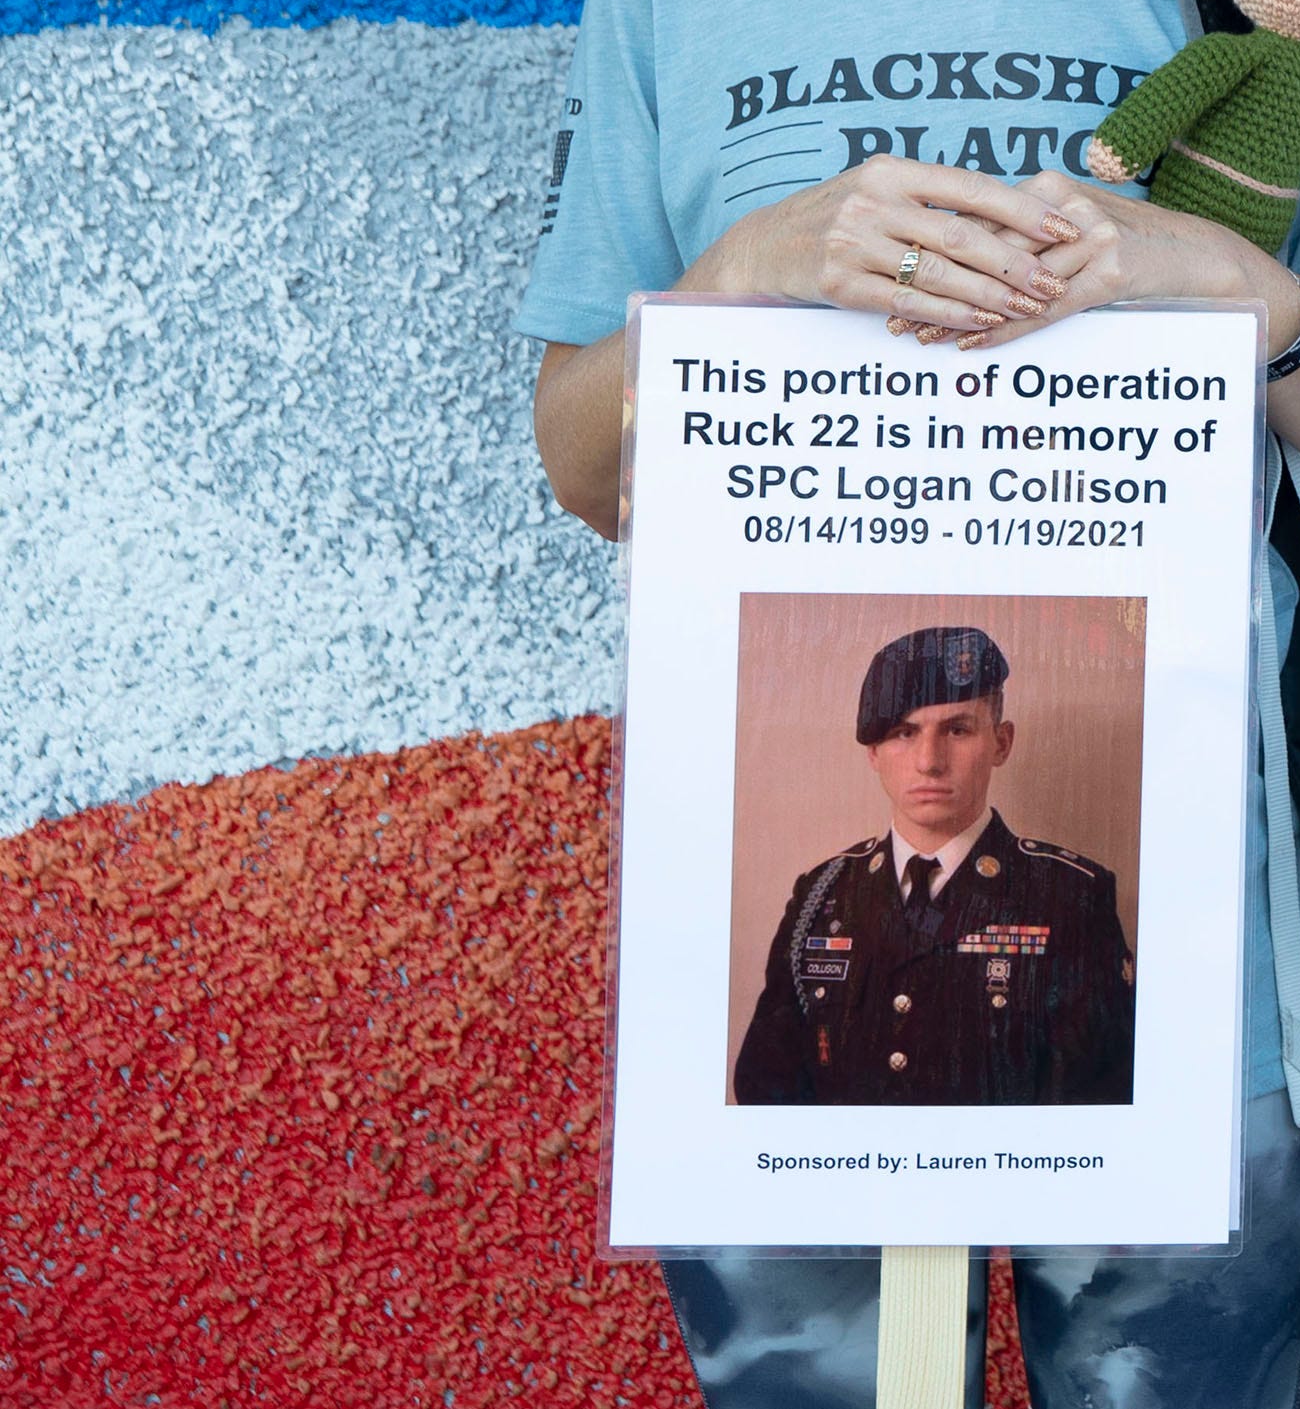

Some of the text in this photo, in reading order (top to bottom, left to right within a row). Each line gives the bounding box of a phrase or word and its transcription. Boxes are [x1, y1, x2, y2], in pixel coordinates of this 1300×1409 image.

[673, 359, 1226, 407] This portion of Operation
[684, 411, 1217, 461] Ruck 22 is in memory of
[727, 465, 1166, 509] SPC Logan Collison
[744, 516, 929, 544] 08/14/1999
[965, 518, 1143, 547] 01/19/2021
[757, 1153, 1103, 1173] Sponsored by: Lauren Thompson
